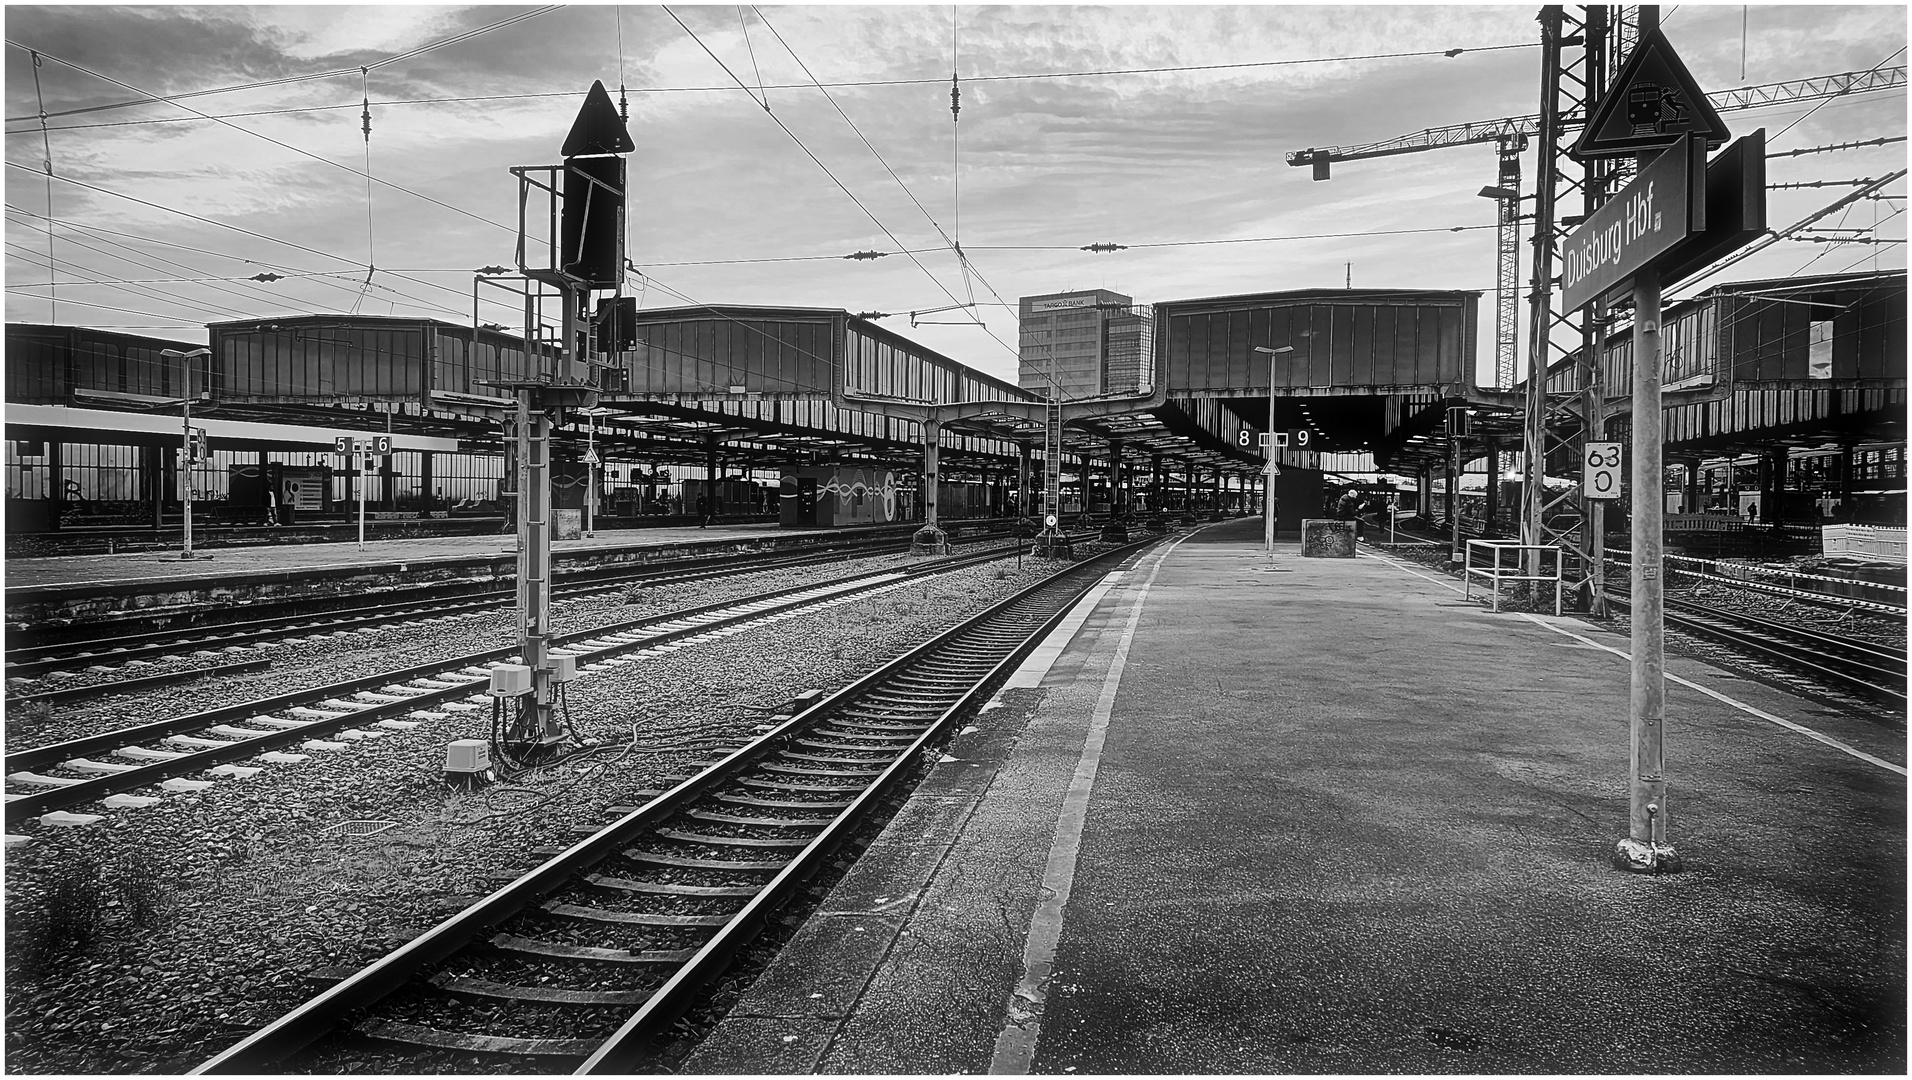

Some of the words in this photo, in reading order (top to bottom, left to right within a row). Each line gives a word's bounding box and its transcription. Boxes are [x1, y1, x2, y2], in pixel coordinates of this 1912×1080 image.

[1567, 219, 1622, 289] Duisburg
[1626, 180, 1654, 246] Hbf
[336, 437, 346, 452] 5
[378, 437, 388, 451] 6
[1239, 430, 1250, 446] 8
[1297, 430, 1309, 446] 9
[1587, 446, 1620, 468] 63
[1594, 470, 1613, 493] 0
[884, 471, 895, 522] 6
